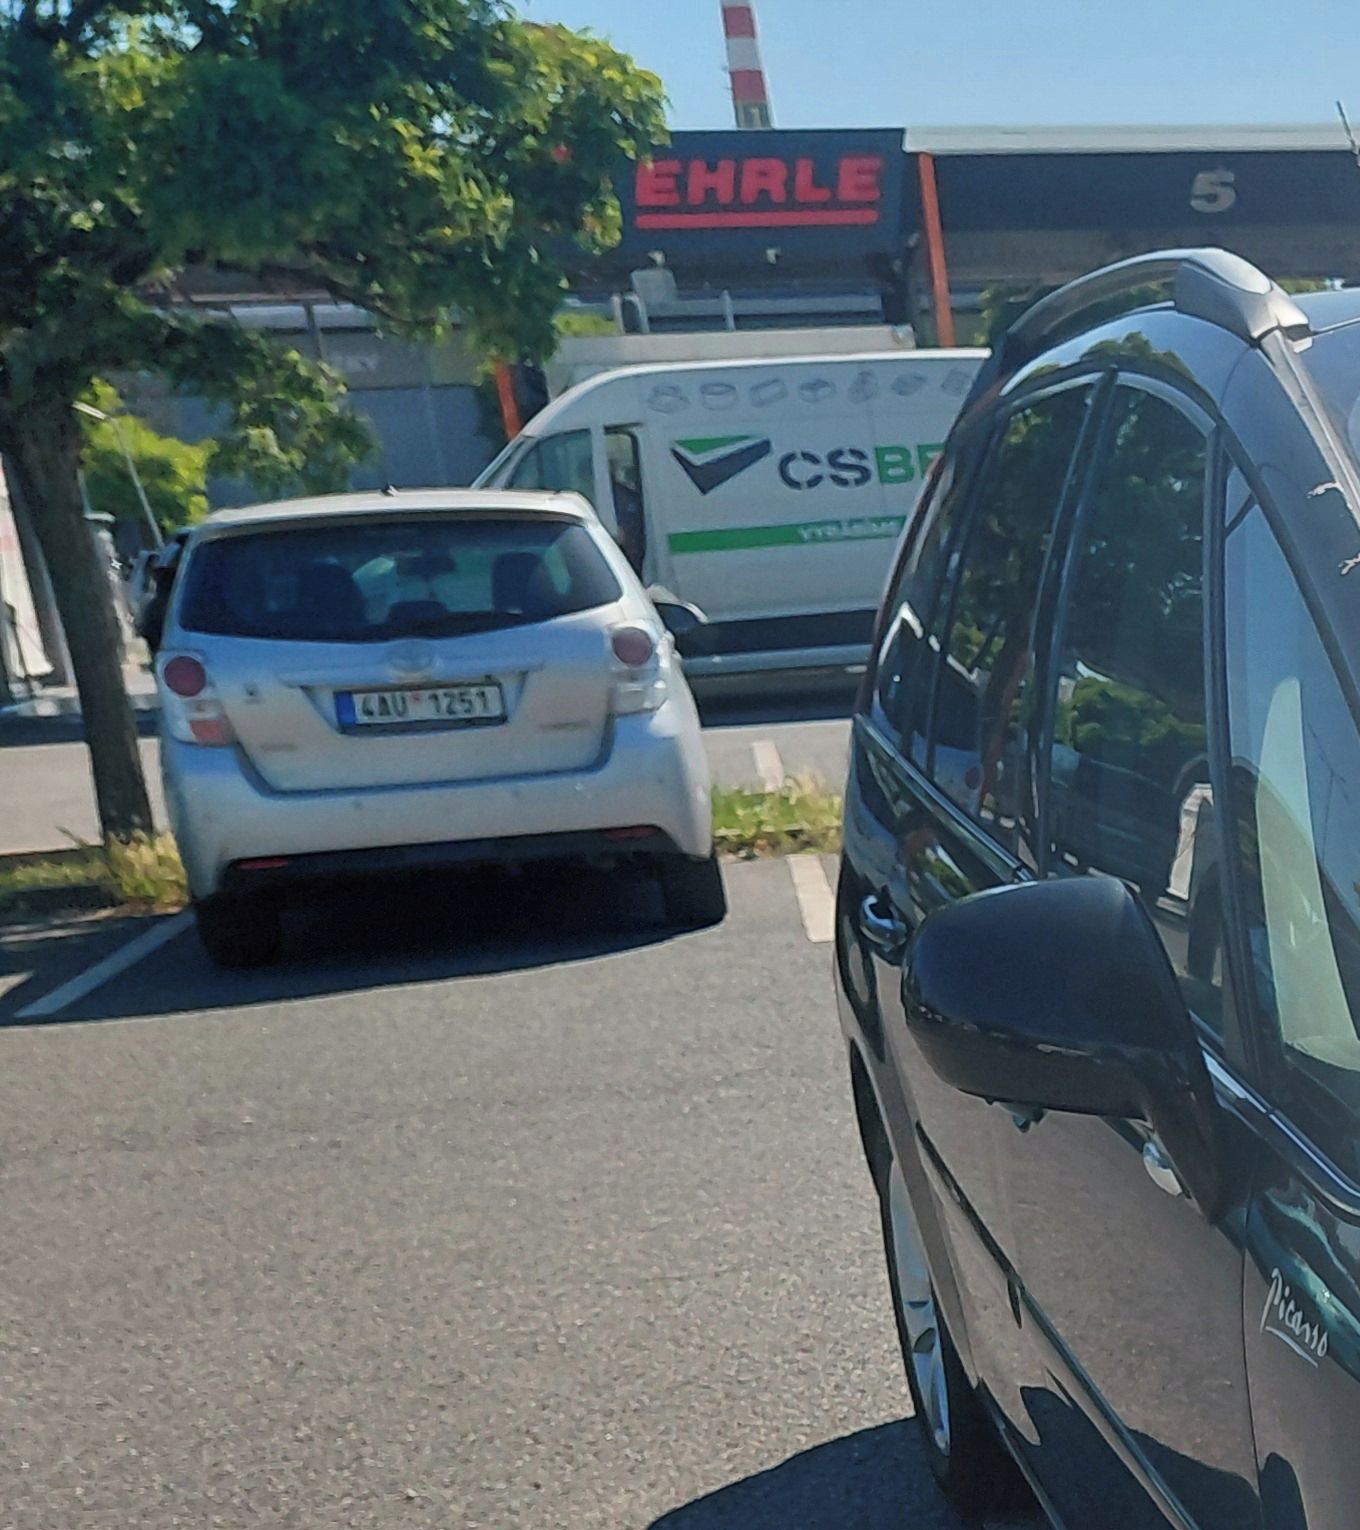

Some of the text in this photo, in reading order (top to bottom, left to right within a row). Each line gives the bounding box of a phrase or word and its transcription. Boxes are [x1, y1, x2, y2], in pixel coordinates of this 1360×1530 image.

[635, 157, 882, 206] EHRLE
[1189, 169, 1236, 213] 5
[428, 690, 490, 715] 1251
[1260, 1267, 1330, 1358] Picasso
